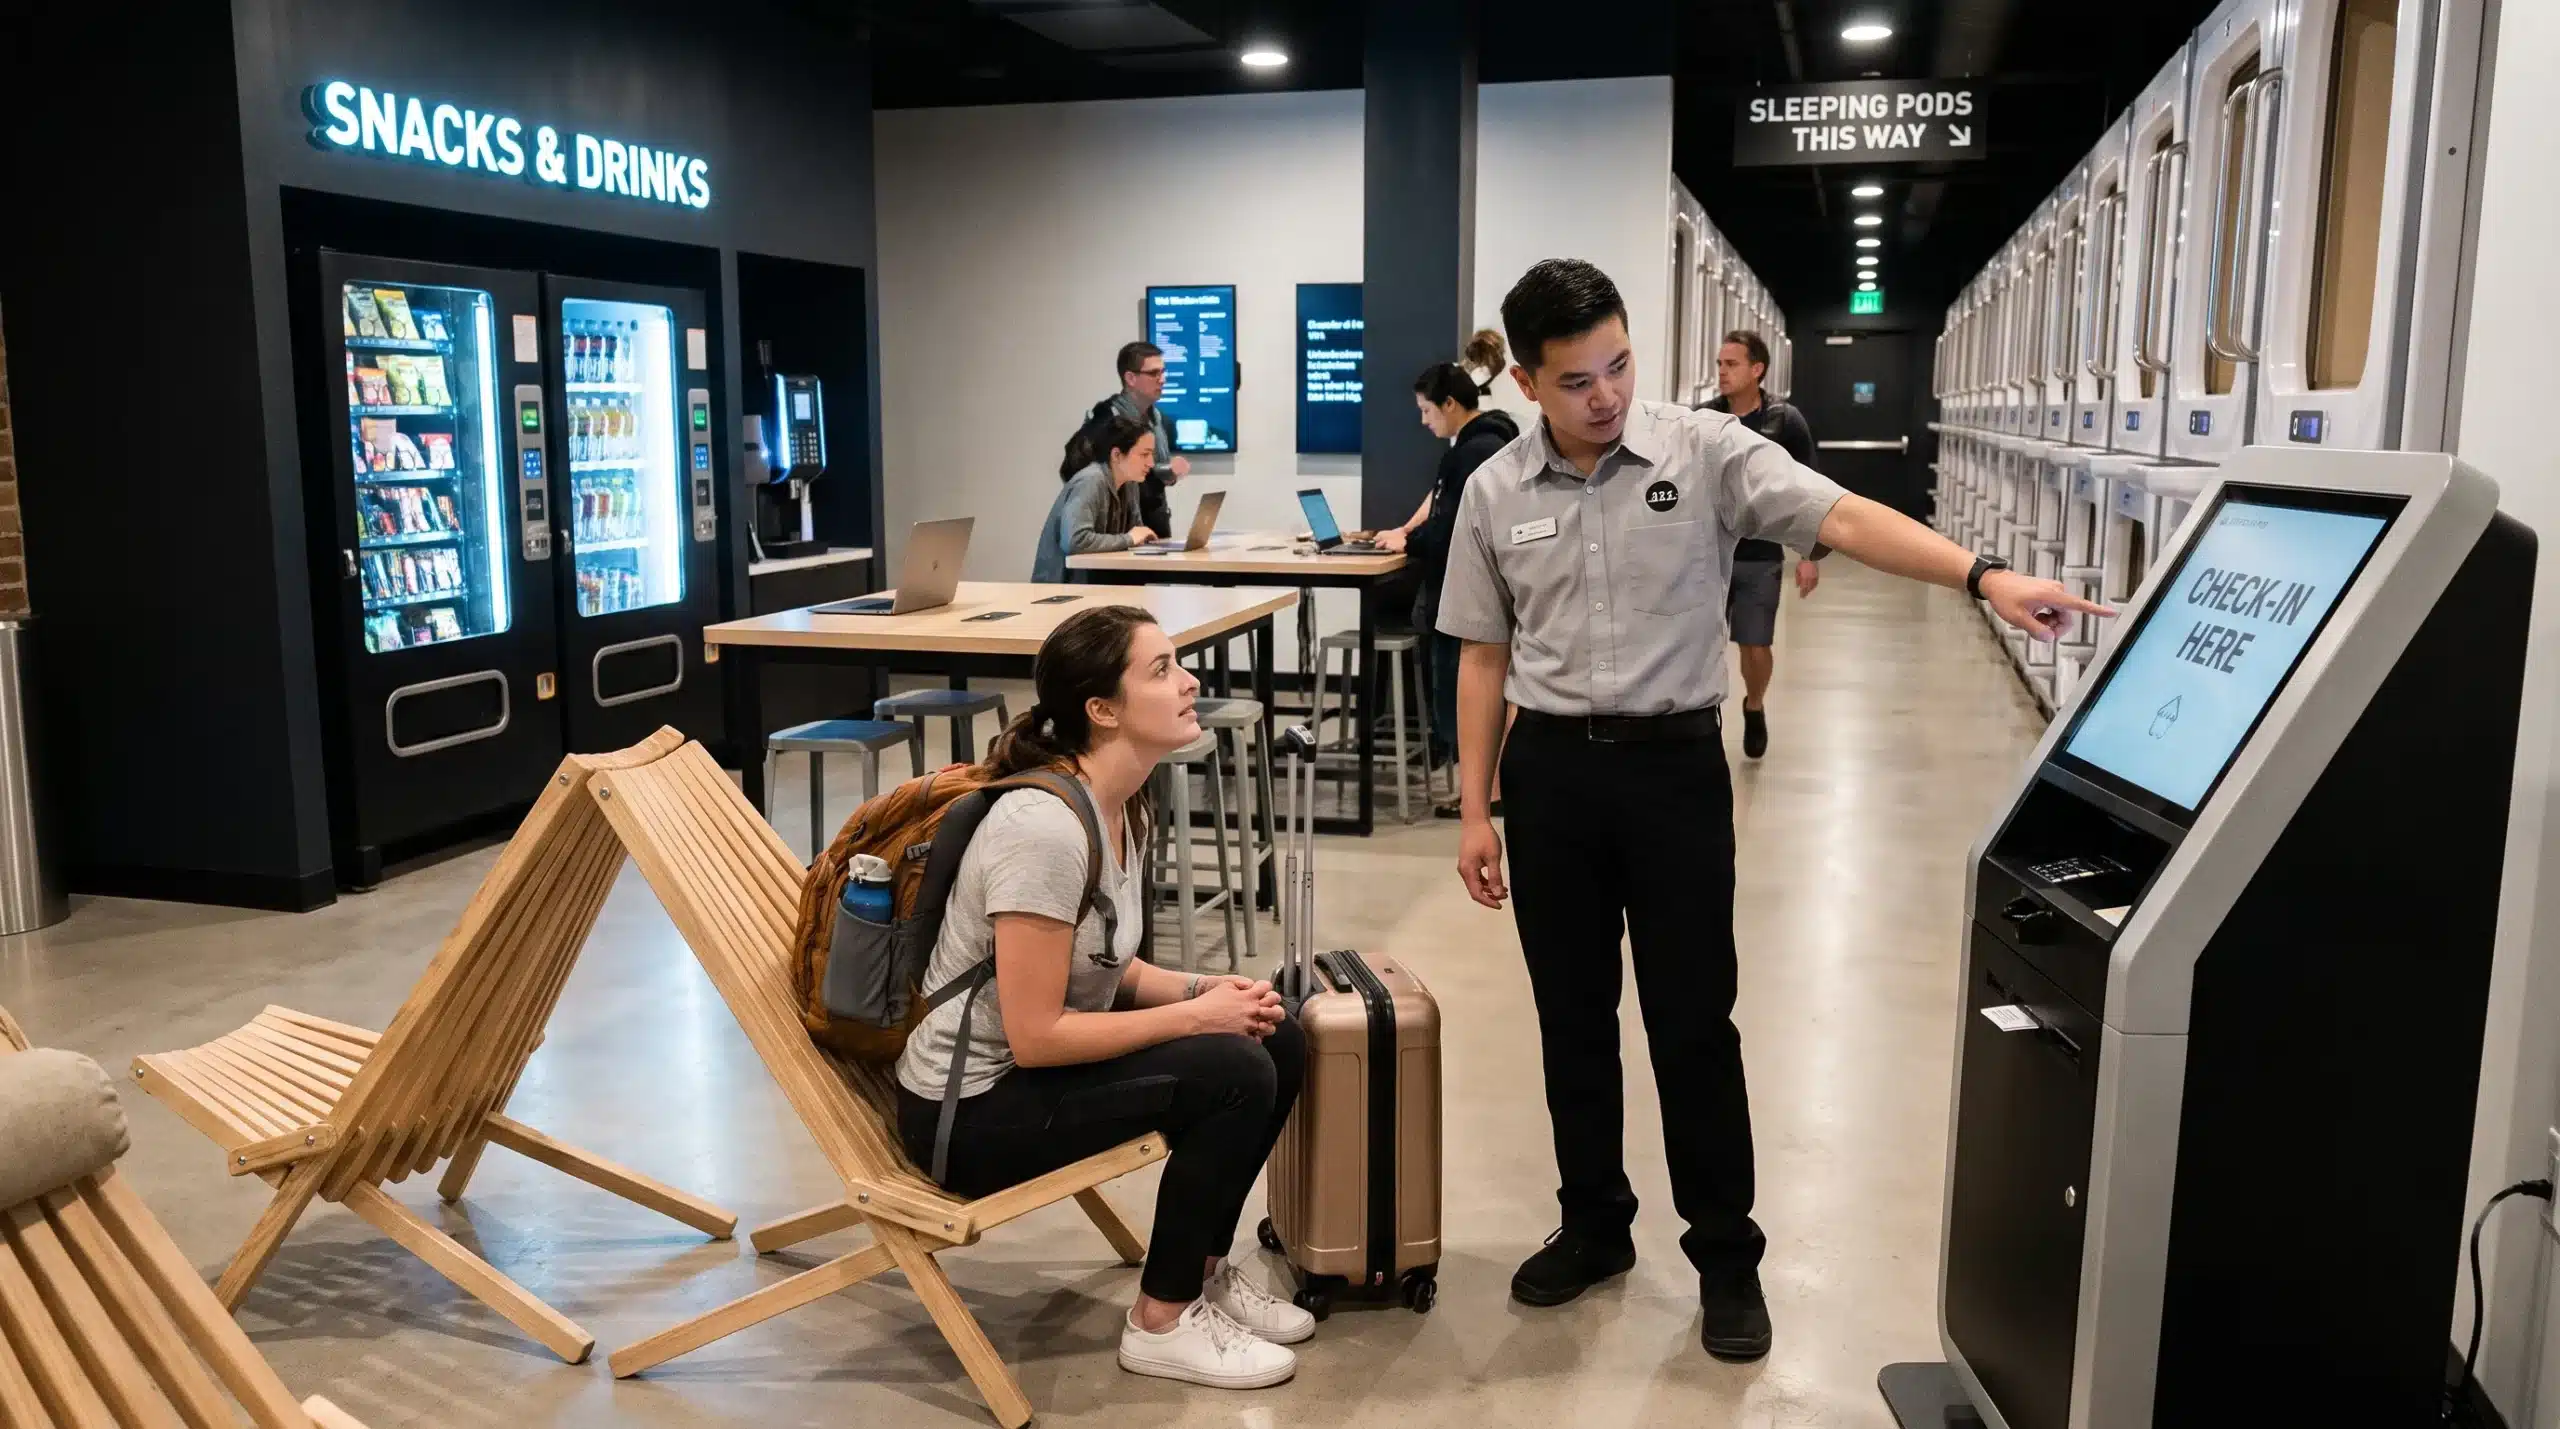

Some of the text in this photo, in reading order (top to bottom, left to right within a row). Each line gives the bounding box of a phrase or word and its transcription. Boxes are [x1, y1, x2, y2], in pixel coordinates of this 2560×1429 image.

[1749, 91, 1973, 123] SLEEPING PODS
[324, 80, 711, 209] SNACKS & DRINKS
[1791, 123, 1927, 152] THIS WAY
[2187, 567, 2316, 627] CHECK-IN
[2175, 620, 2257, 674] HERE
